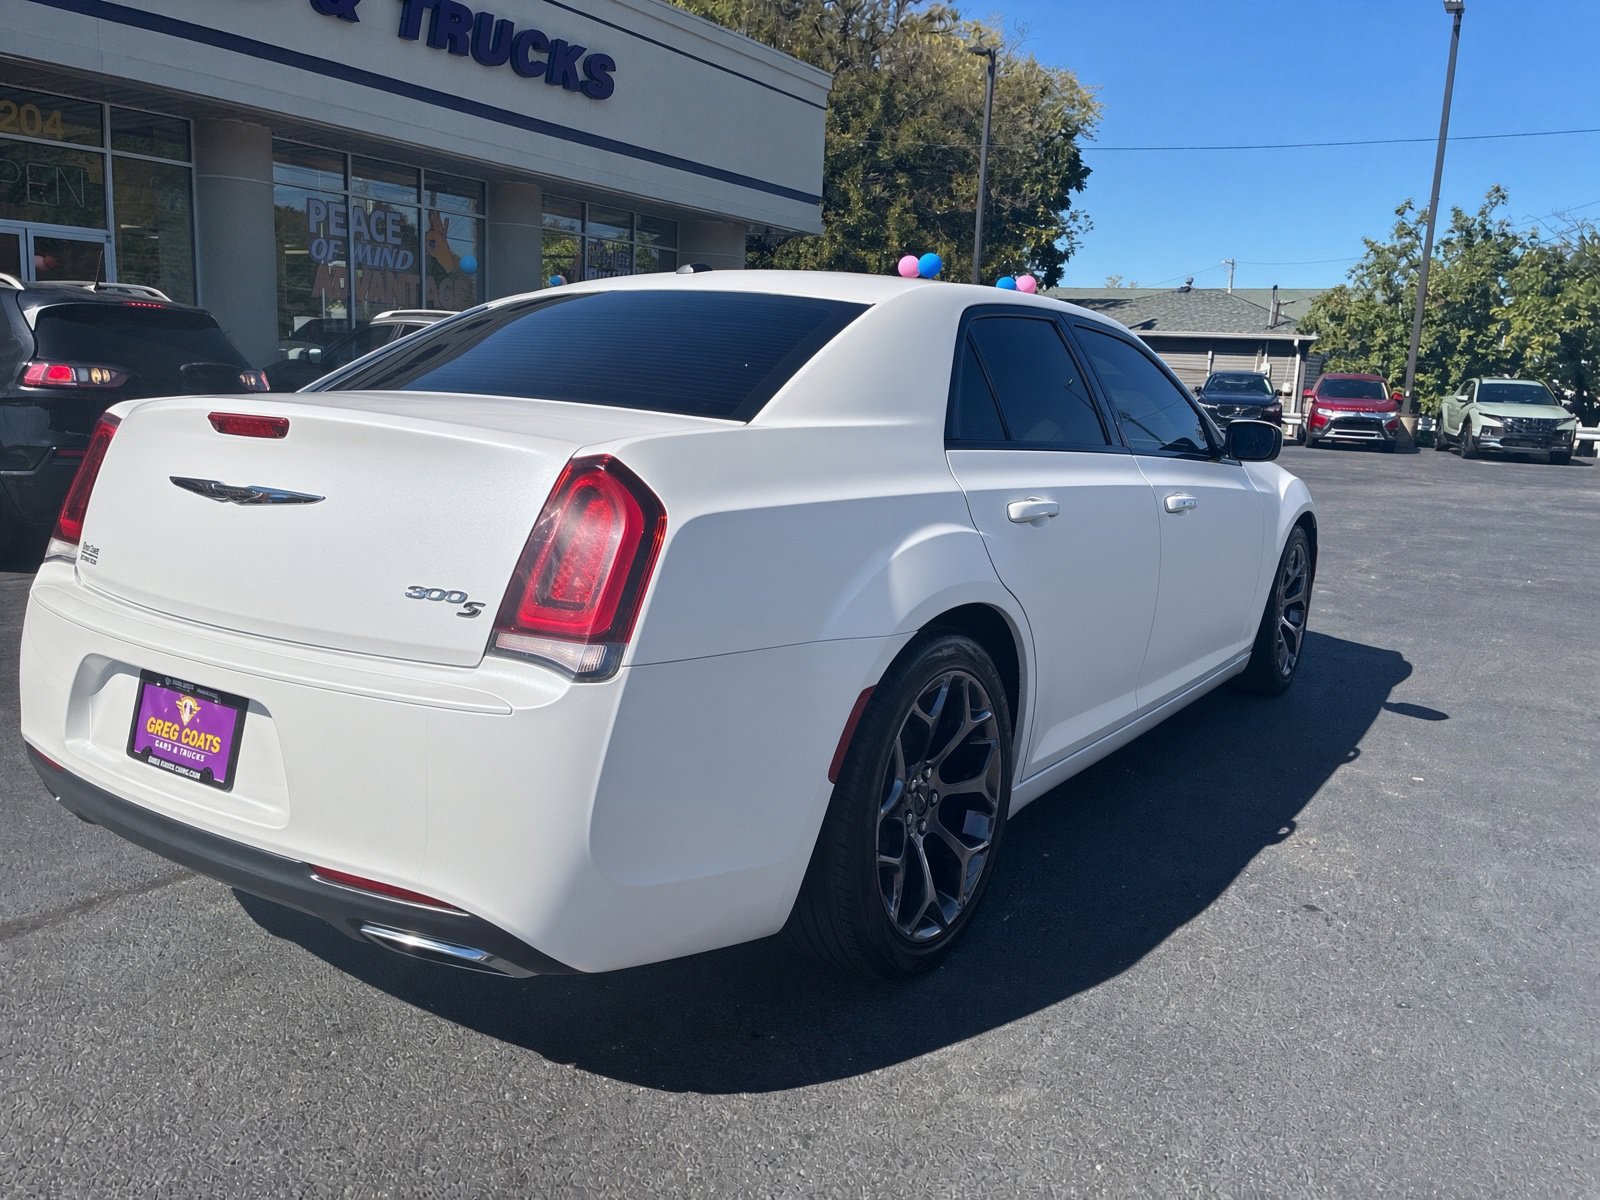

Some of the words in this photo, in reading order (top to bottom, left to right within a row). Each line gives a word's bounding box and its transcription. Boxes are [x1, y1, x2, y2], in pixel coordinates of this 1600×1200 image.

[398, 0, 616, 100] TRUCKS
[307, 198, 402, 245] PEACE
[310, 238, 343, 264] OF
[353, 241, 414, 273] MIND
[405, 586, 468, 604] 300
[146, 717, 180, 741] GREG
[181, 728, 221, 753] COATS
[155, 740, 172, 752] CARS
[180, 748, 205, 762] TRUCKS
